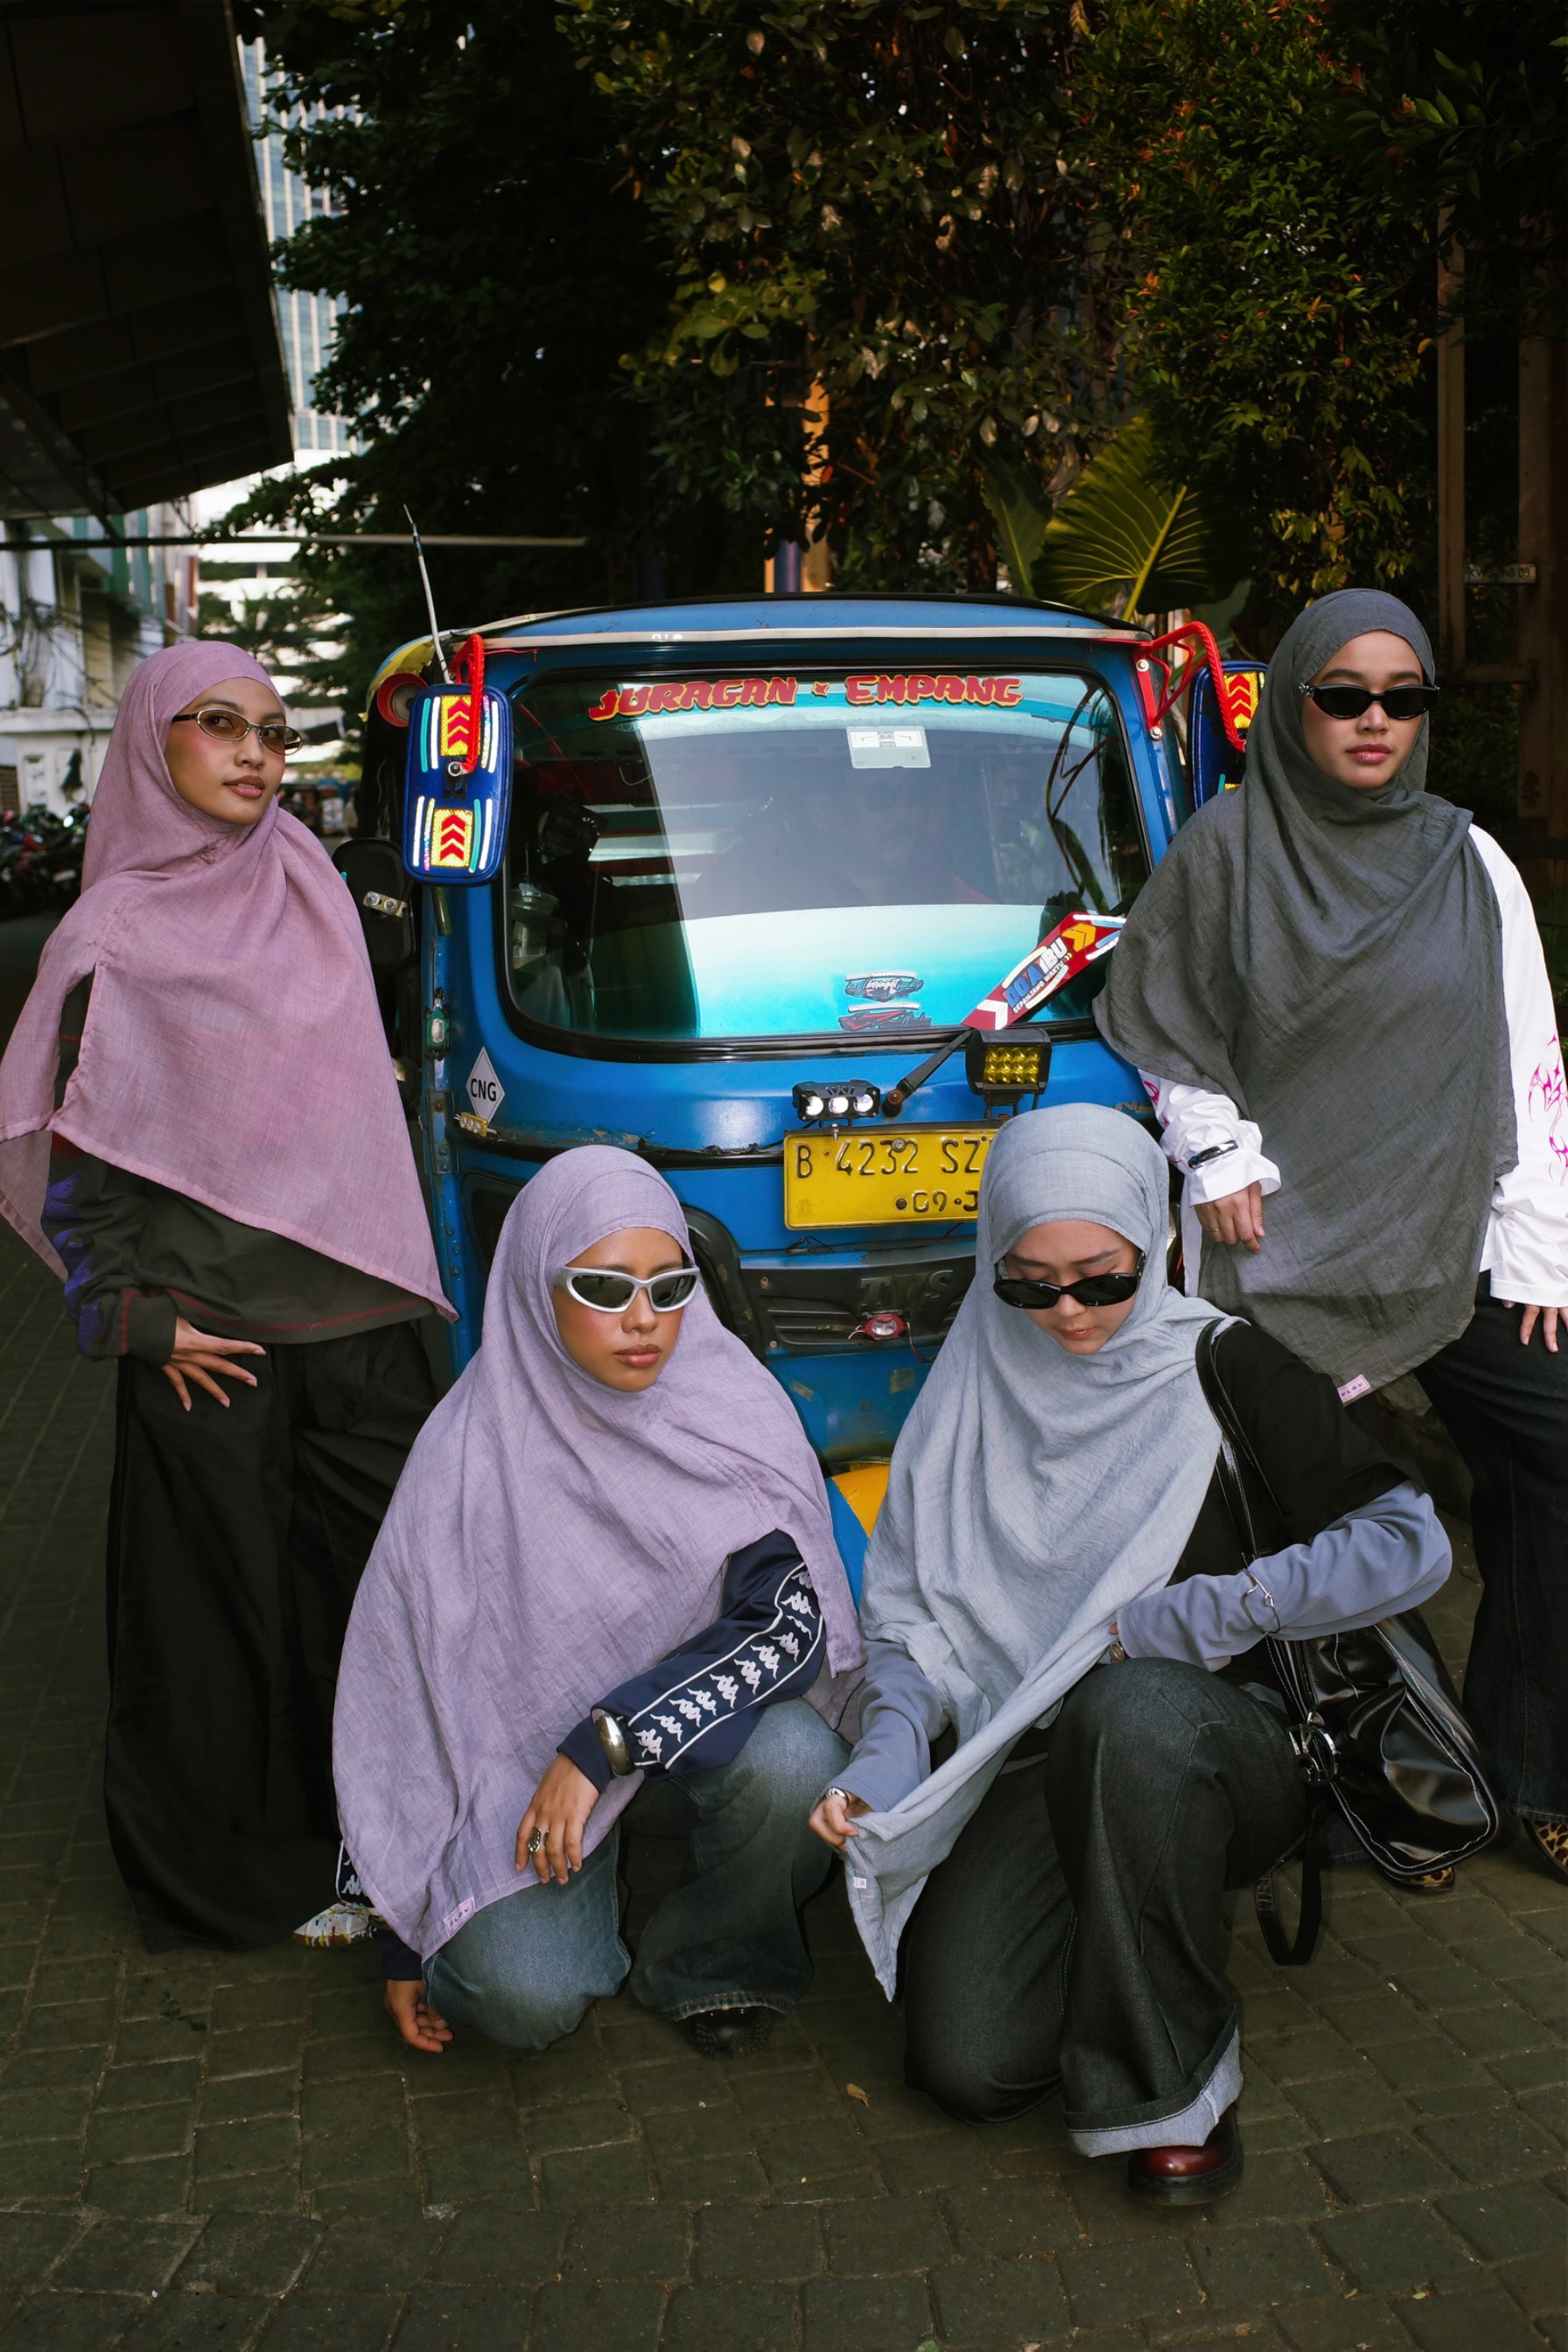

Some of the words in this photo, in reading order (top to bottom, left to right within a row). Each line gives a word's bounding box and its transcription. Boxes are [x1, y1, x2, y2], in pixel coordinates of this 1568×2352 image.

[588, 677, 798, 721] JURAGAN
[845, 675, 1024, 708] EMPANG
[1040, 937, 1068, 975] IBU
[1012, 980, 1046, 1014] SEPANJANG
[1044, 961, 1064, 982] WAKTU
[470, 1078, 496, 1102] CNG
[796, 1143, 813, 1179] B
[835, 1138, 919, 1176] 4232
[941, 1138, 993, 1173] SZ
[859, 1269, 954, 1309] TVS
